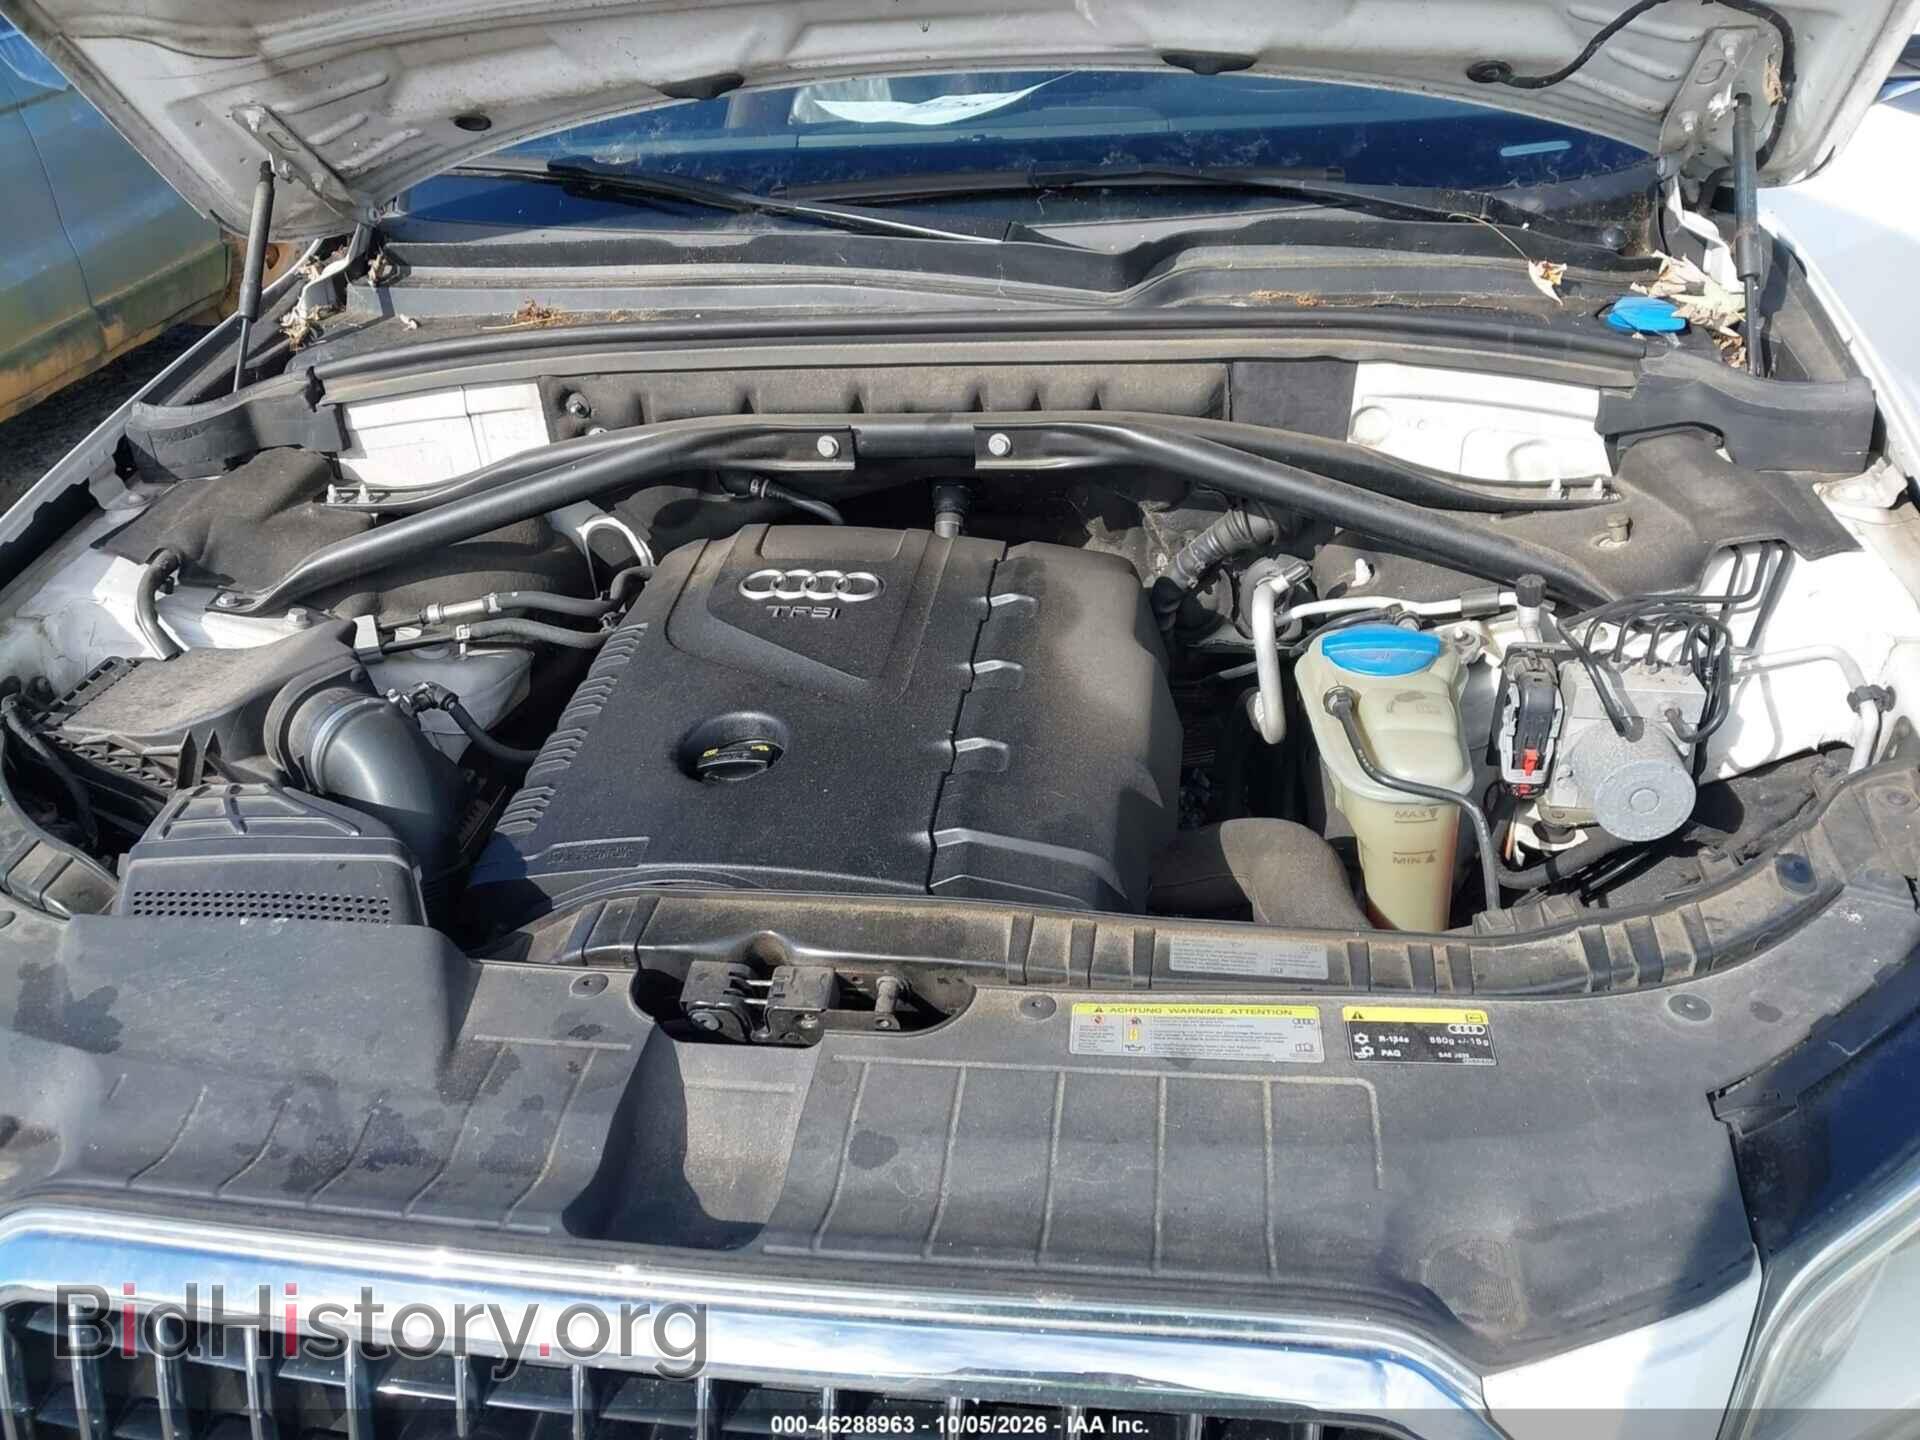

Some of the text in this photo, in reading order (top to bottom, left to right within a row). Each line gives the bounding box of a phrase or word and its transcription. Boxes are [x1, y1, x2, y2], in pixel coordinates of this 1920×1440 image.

[766, 605, 839, 619] TFSI
[1394, 808, 1429, 817] MAX
[1393, 856, 1421, 865] MIN
[1109, 1007, 1162, 1015] ACHTUNG
[1229, 1008, 1293, 1016] ATTENTION
